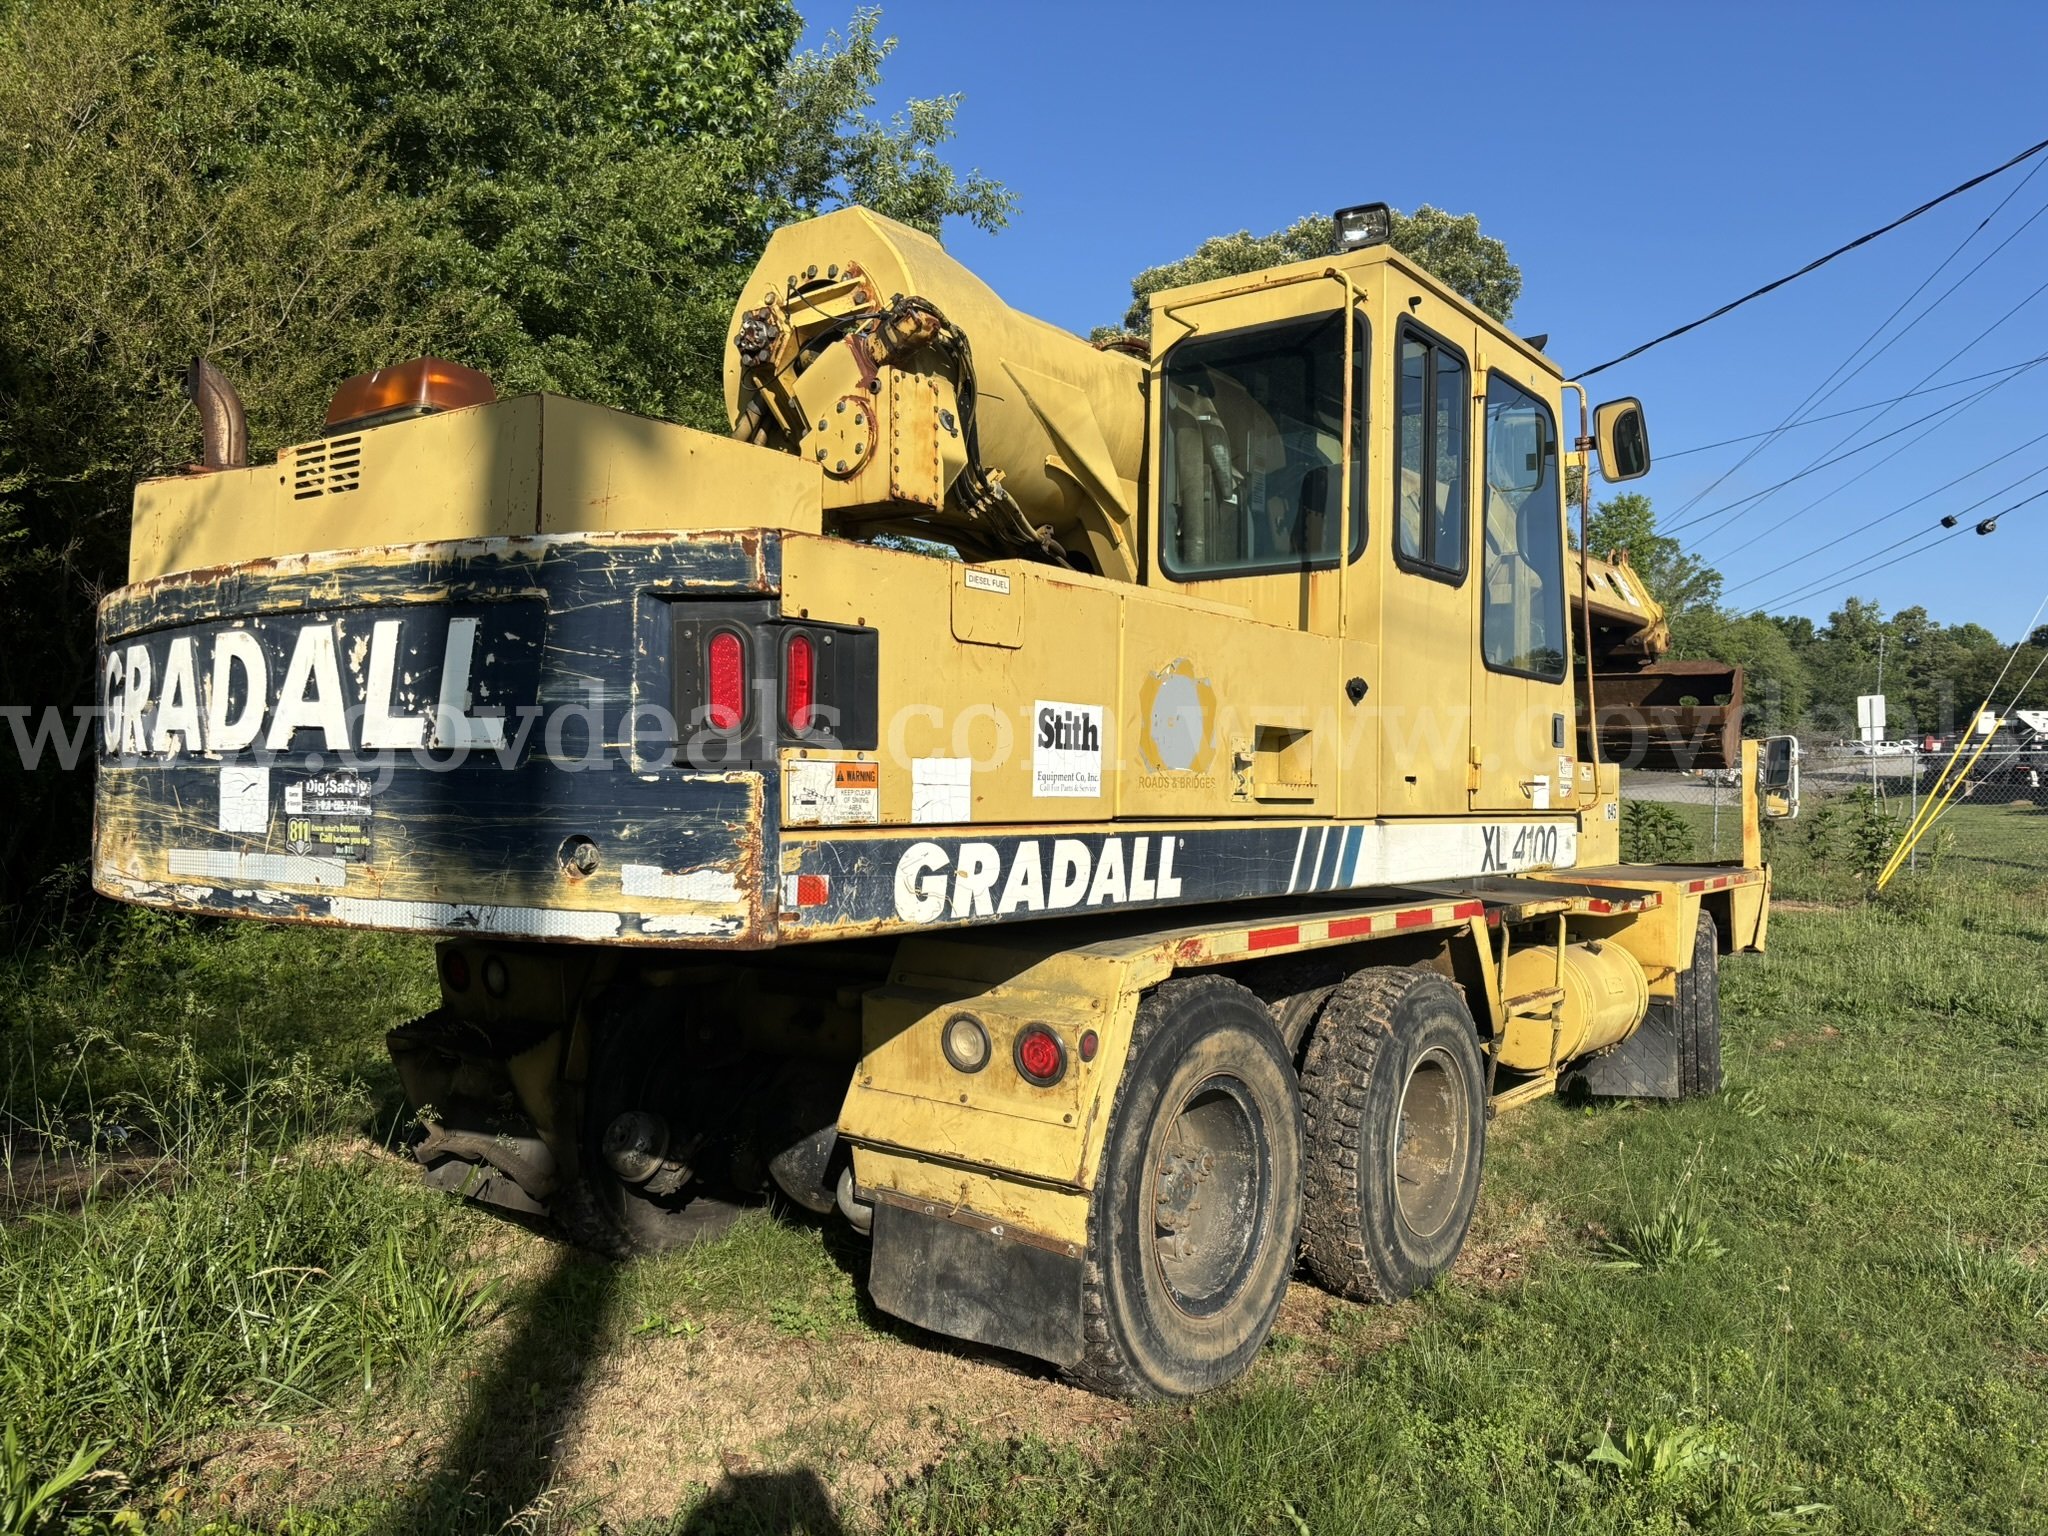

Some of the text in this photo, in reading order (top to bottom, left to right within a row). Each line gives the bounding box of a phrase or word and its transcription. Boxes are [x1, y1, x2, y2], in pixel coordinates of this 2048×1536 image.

[969, 575, 1008, 589] DIESEL FUEL
[104, 616, 506, 755] GRADALL
[1038, 707, 1099, 752] Stith
[846, 771, 875, 782] WARNING
[1037, 771, 1075, 784] Equipment
[1087, 772, 1099, 782] Inc.
[1138, 776, 1216, 789] ROADS & BRIDGES
[306, 780, 325, 797] Dig
[1607, 803, 1617, 820] 645
[289, 820, 310, 842] 811
[320, 832, 332, 843] Call
[1480, 825, 1557, 872] XL 4100
[894, 836, 1182, 923] GRADALL
